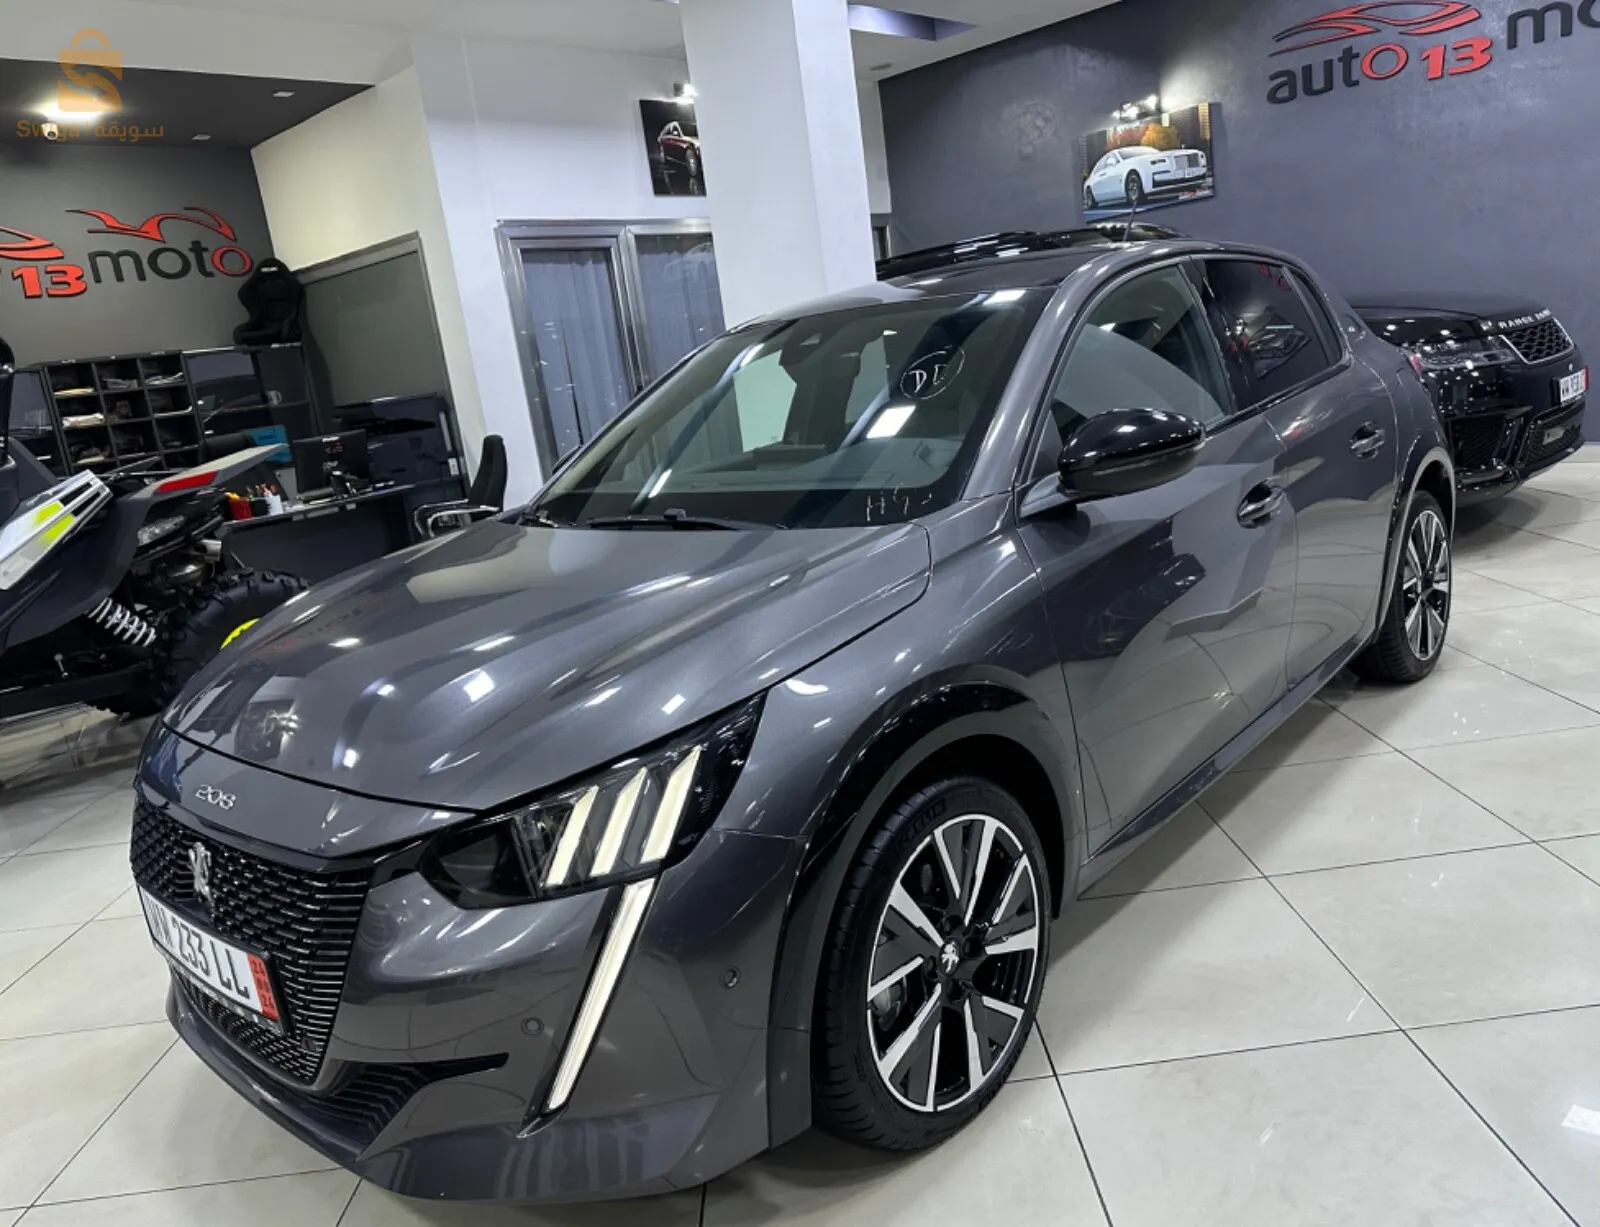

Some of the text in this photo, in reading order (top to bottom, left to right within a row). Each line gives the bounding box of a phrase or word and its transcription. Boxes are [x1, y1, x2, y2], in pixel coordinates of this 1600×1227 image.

[1266, 43, 1408, 104] auto
[1420, 36, 1493, 81] 13
[11, 240, 252, 299] 13 moto
[195, 784, 236, 811] 208
[171, 916, 210, 976] 233
[209, 940, 250, 1000] LL
